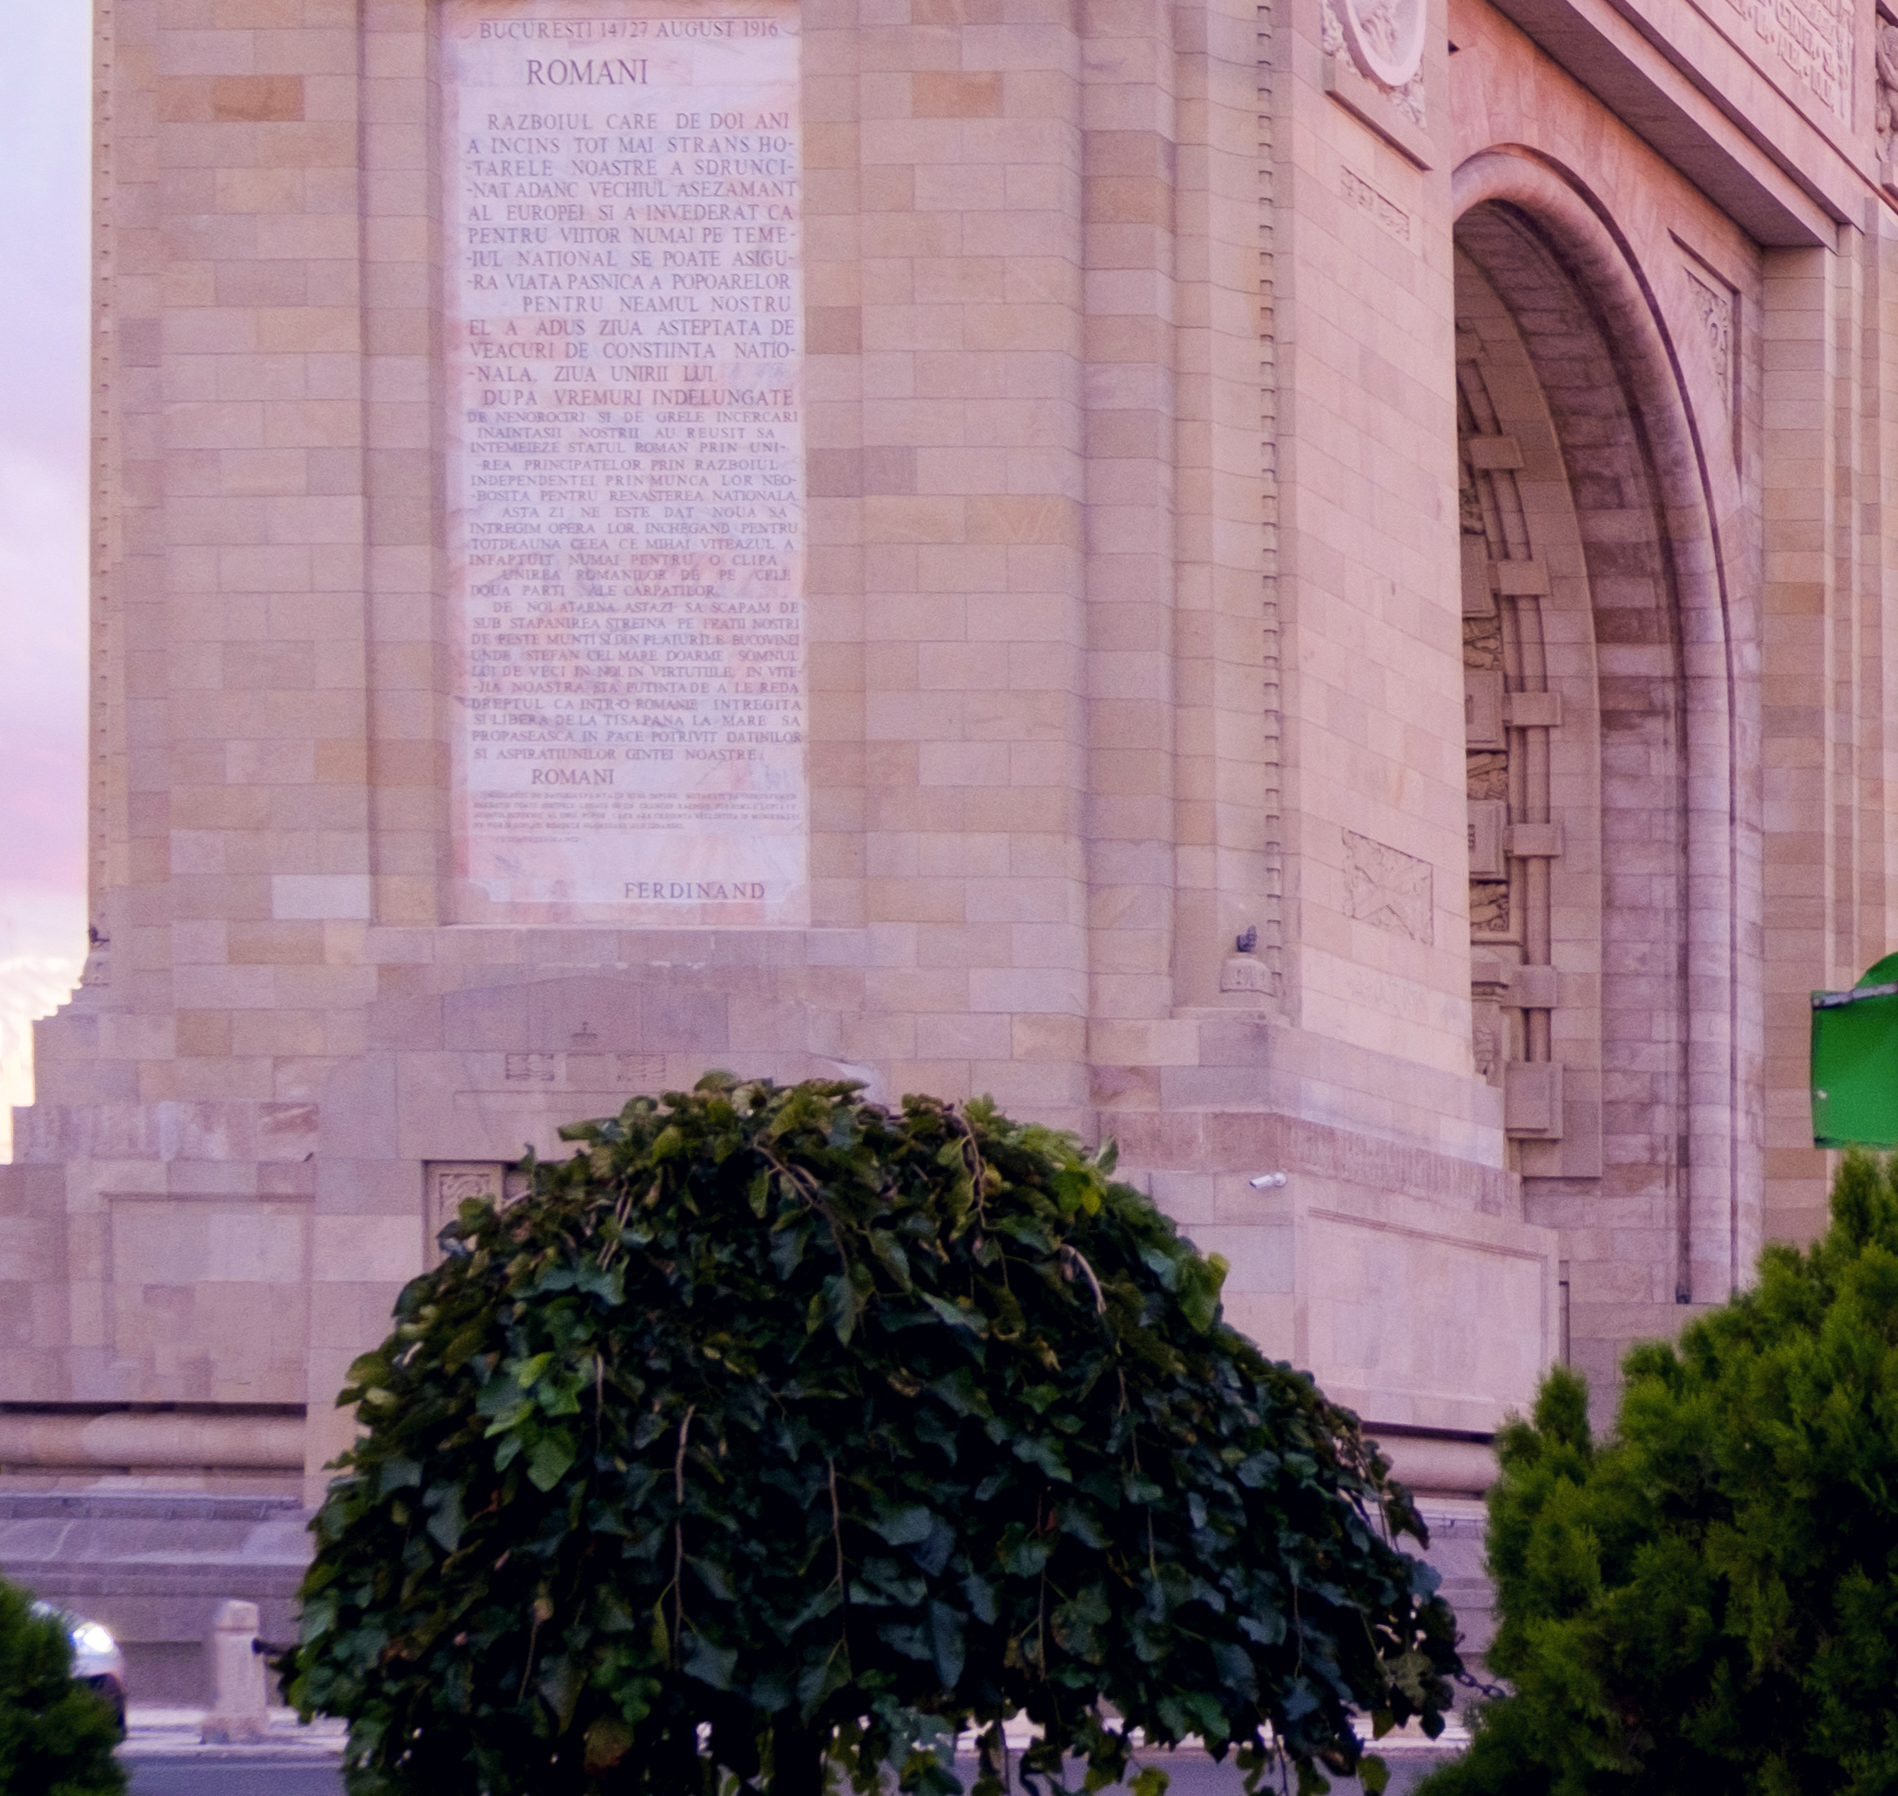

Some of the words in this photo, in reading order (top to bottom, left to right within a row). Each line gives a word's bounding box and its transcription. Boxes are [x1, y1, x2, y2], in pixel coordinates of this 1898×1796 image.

[479, 21, 593, 40] BUCURESTI
[655, 21, 736, 40] AUGUST
[742, 21, 780, 40] 1916
[525, 58, 649, 86] ROMANI
[487, 112, 594, 131] RAZBOIUL
[605, 112, 659, 131] CARE
[675, 112, 702, 131] DE
[709, 112, 745, 131] DOI
[754, 112, 790, 131] ANI
[466, 137, 481, 155] A
[490, 137, 561, 155] INCINS
[573, 137, 610, 155] TOT
[618, 137, 654, 155] MAI
[666, 137, 751, 155] STRANS
[758, 137, 794, 155] HO-
[570, 159, 658, 177] NOASTRE
[670, 159, 685, 177] A
[694, 159, 795, 177] SDRUNCI-
[516, 181, 579, 199] ADANC
[588, 181, 670, 199] VECHIUL
[676, 181, 797, 199] ASEZAMANT
[468, 203, 494, 222] AL
[506, 203, 586, 222] EUROPEI
[598, 203, 615, 222] SI
[623, 203, 638, 222] A
[646, 203, 760, 222] INVEDERAT
[767, 203, 794, 222] CA
[468, 226, 549, 245] PENTRU
[559, 226, 622, 245] VIITOR
[631, 226, 694, 245] NUMAI
[702, 226, 724, 245] PE
[731, 226, 796, 245] TEME-
[516, 250, 619, 268] NATIONAL
[629, 250, 653, 268] SE
[662, 250, 721, 268] POATE
[731, 250, 796, 268] ASIGU-
[504, 273, 562, 291] VIATA
[567, 273, 644, 291] PASNICA
[650, 273, 663, 291] A
[671, 273, 791, 291] POPOARELOR
[522, 295, 604, 314] PENTRU
[619, 295, 700, 314] NEAMUL
[710, 295, 792, 314] NOSTRU
[468, 318, 492, 337] EL
[504, 318, 519, 337] A
[535, 318, 587, 337] ADUS
[598, 318, 643, 337] ZIUA
[656, 318, 762, 337] ASTEPTATA
[770, 318, 795, 337] DE
[469, 341, 555, 360] VEACURI
[564, 341, 590, 360] DE
[601, 341, 717, 360] CONSTIINTA
[734, 341, 797, 360] NATIO-
[552, 365, 598, 383] ZIUA
[610, 365, 669, 383] UNIRII
[483, 388, 539, 407] DUPA
[553, 388, 643, 407] VREMURI
[652, 388, 794, 407] INDELUNGATE
[623, 411, 645, 424] DE
[655, 411, 705, 424] GRELE
[655, 427, 677, 440] AU
[686, 427, 747, 440] REUSIT
[756, 427, 776, 440] SA
[567, 442, 627, 454] STATUL
[633, 442, 689, 454] ROMAN
[698, 442, 738, 454] PRIN
[650, 459, 686, 472] PRIN
[694, 459, 779, 472] RAZBOIUL
[605, 475, 645, 487] PRIN
[649, 475, 710, 487] MUNCA
[539, 490, 599, 503] PENTRU
[530, 768, 615, 786] ROMANI
[624, 882, 766, 900] FERDINAND
